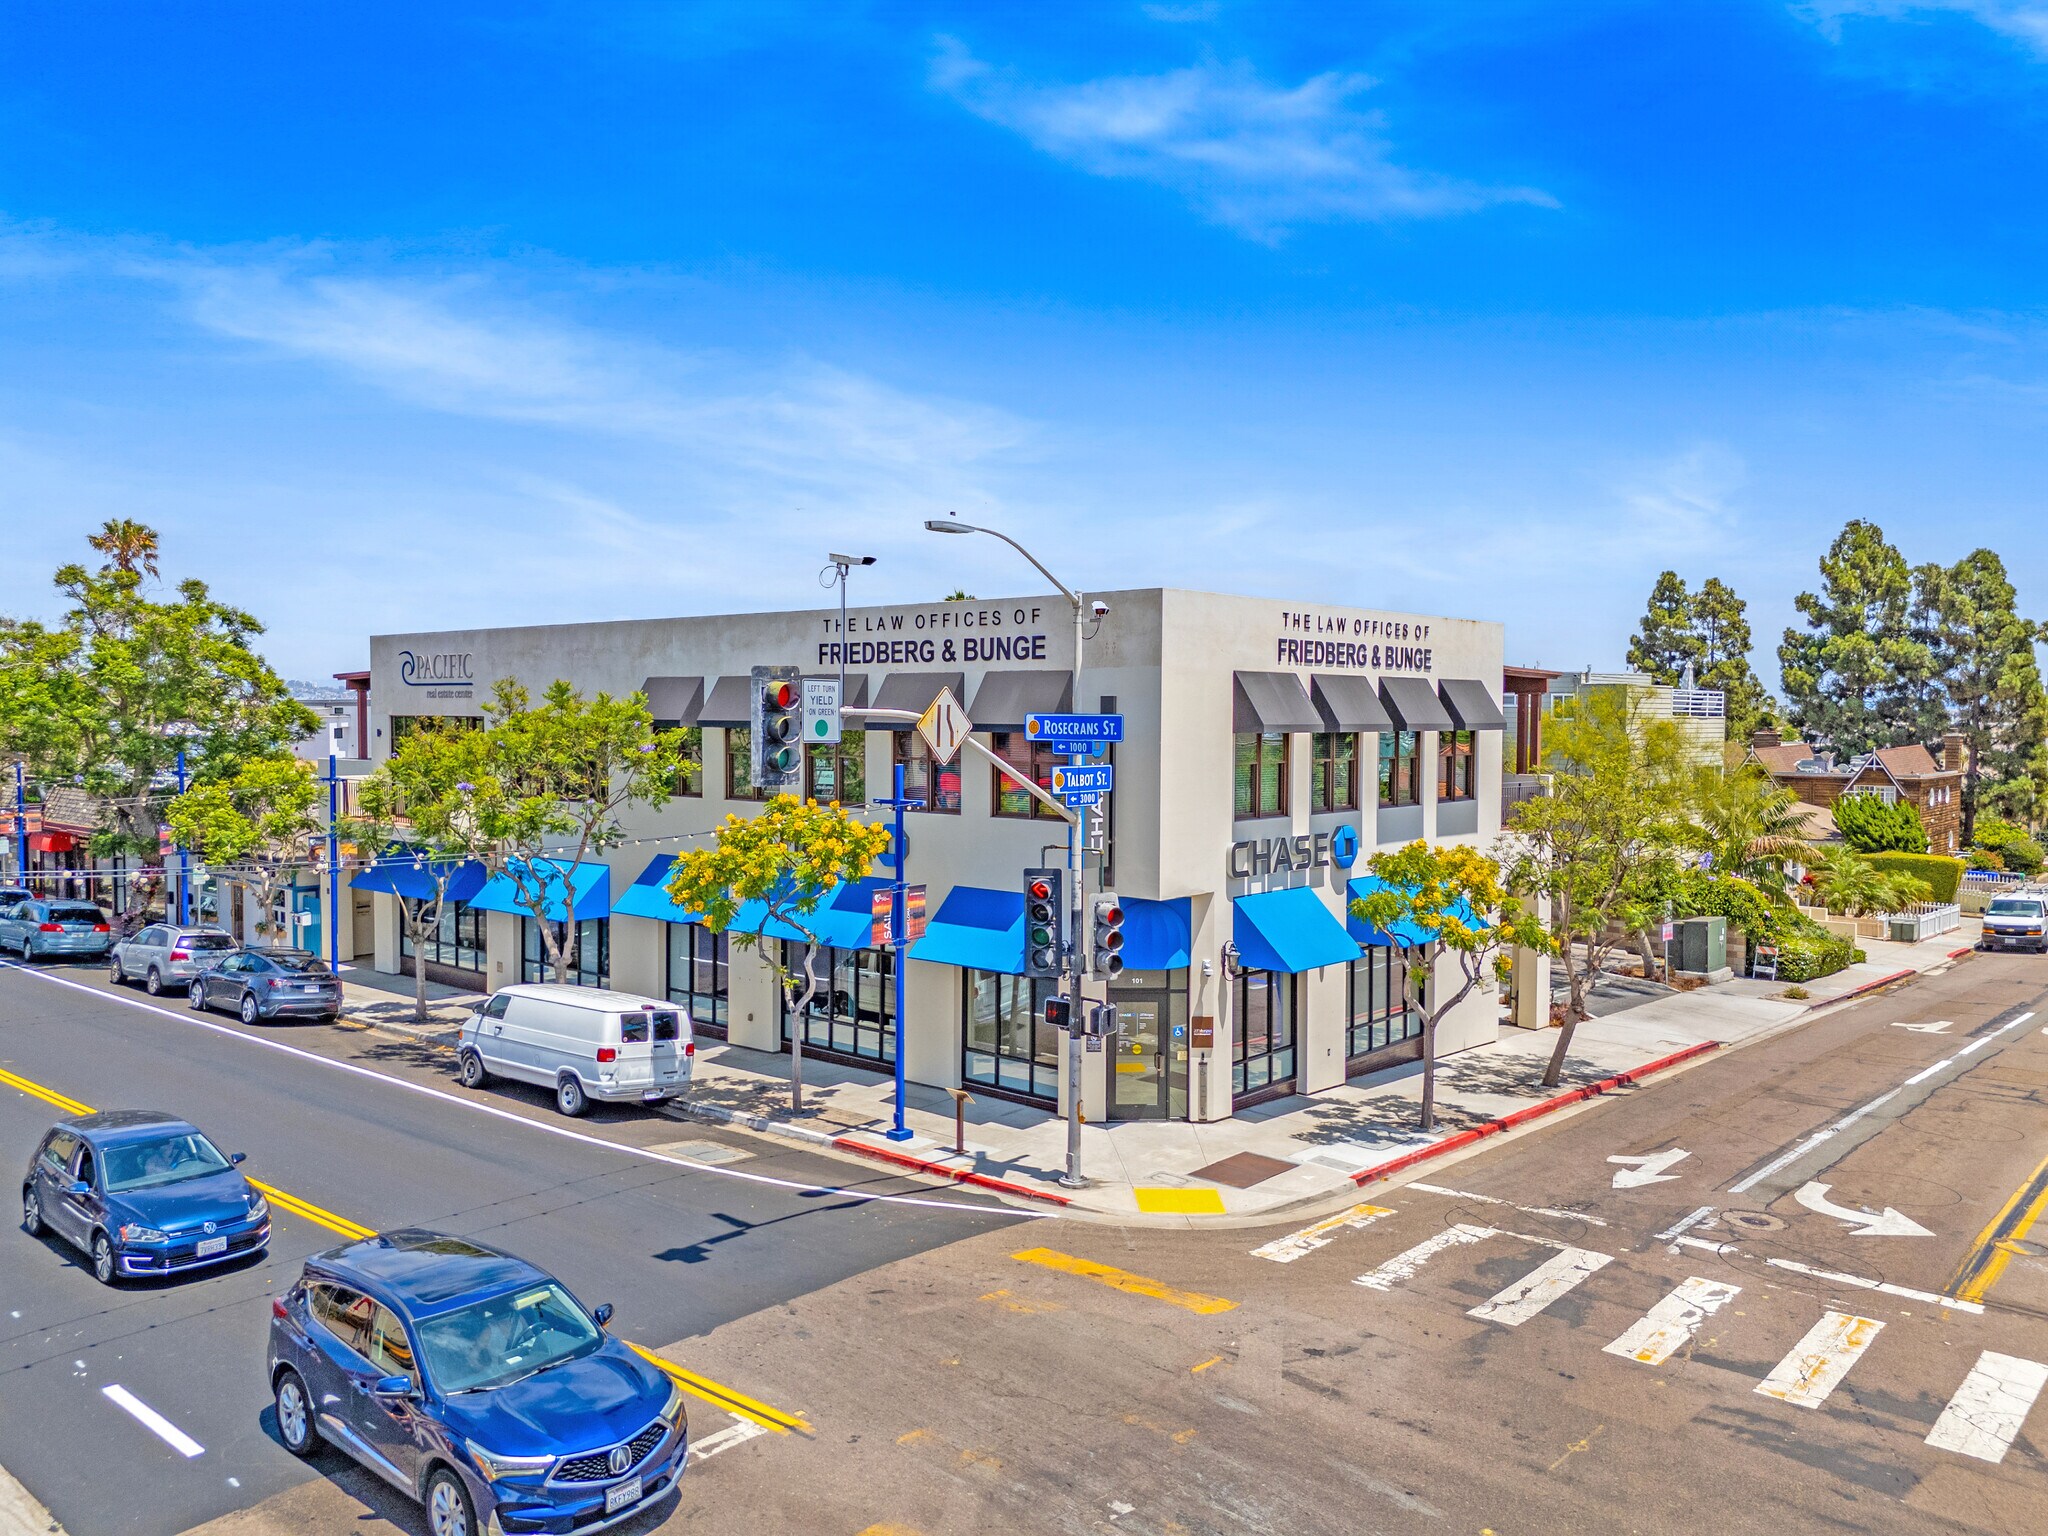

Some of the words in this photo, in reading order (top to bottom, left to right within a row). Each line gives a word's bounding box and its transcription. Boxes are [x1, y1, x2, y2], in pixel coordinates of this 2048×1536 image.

[823, 618, 857, 632] THE
[866, 616, 903, 631] LAW
[915, 611, 1001, 629] OFFICES
[1014, 608, 1041, 625] OF
[1282, 612, 1311, 629] THE
[1317, 615, 1347, 632] LAW
[1354, 619, 1409, 638] OFFICES
[1414, 625, 1430, 640] OF
[818, 639, 935, 665] FRIEDBERG
[941, 639, 957, 662] &
[963, 635, 1047, 662] BUNGE
[1277, 638, 1368, 667] FRIEDBERG
[1371, 644, 1382, 667] &
[1385, 646, 1432, 670] BUNGE
[416, 653, 474, 679] PACIFIC
[437, 690, 454, 698] estate
[454, 690, 473, 698] center
[810, 696, 834, 705] YIELD
[1044, 720, 1099, 735] ROSECRANS
[1103, 720, 1117, 735] ST.
[1069, 742, 1087, 752] 1000
[1066, 772, 1094, 787] TALBOT
[1096, 771, 1108, 786] ST.
[1079, 793, 1096, 804] 3000
[1230, 832, 1330, 878] CHASE
[884, 910, 892, 939] SAIL
